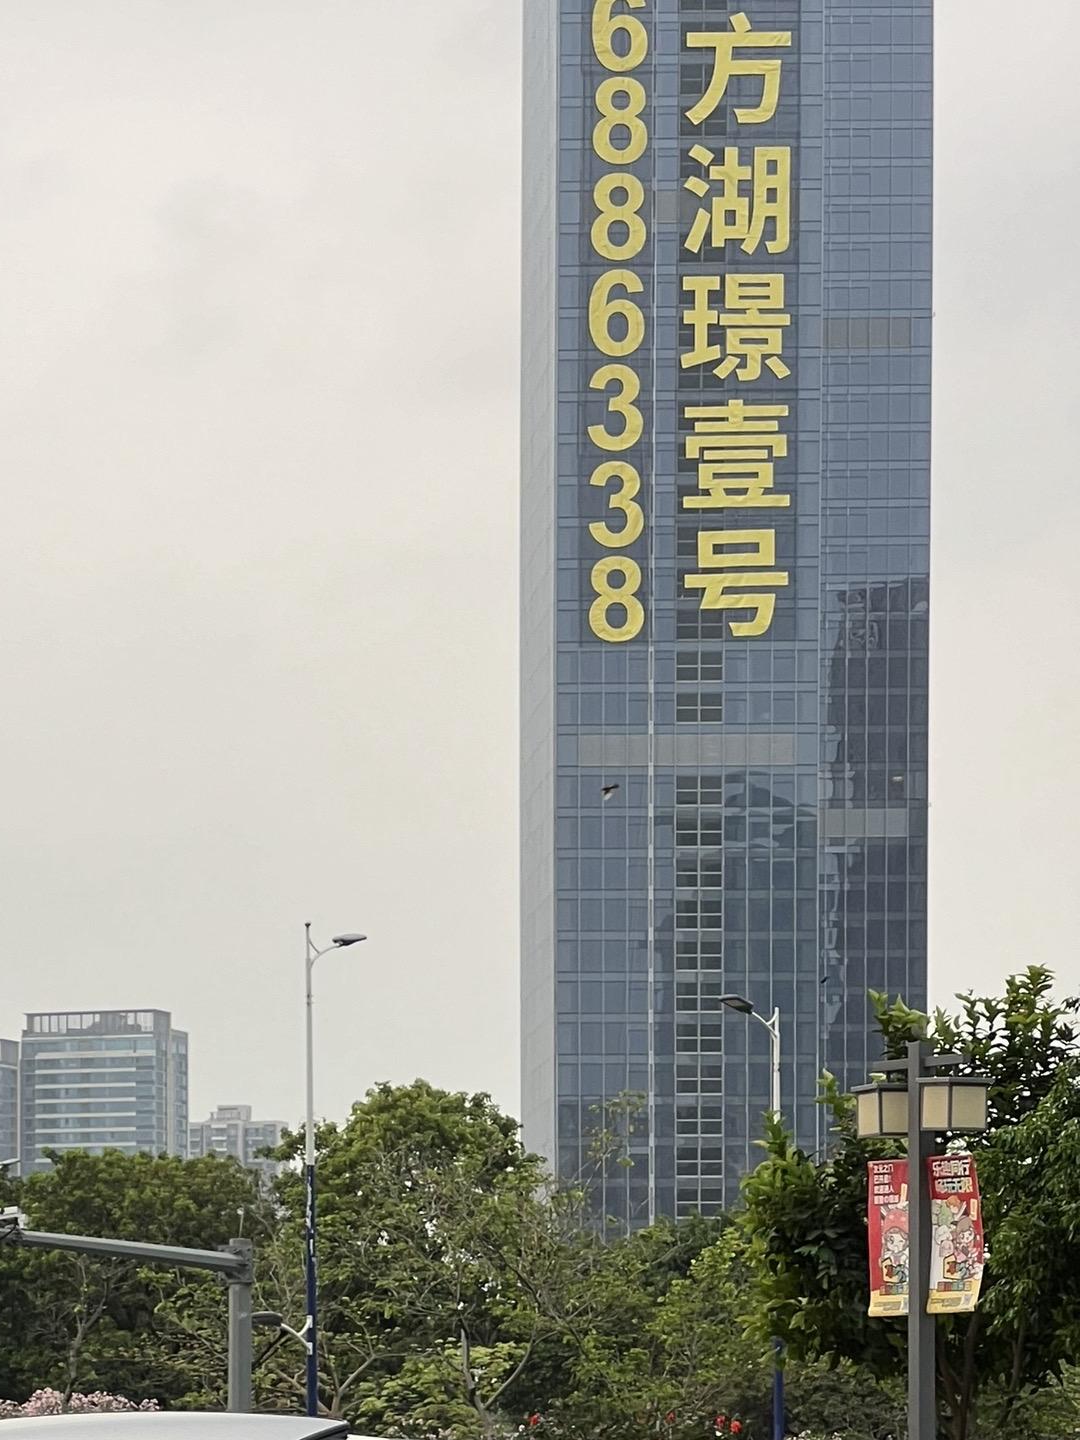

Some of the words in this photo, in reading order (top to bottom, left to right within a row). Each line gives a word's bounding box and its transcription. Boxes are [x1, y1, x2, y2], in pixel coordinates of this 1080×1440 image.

[587, 0, 649, 643] 6886338
[680, 12, 793, 638] 方湖璟壹号
